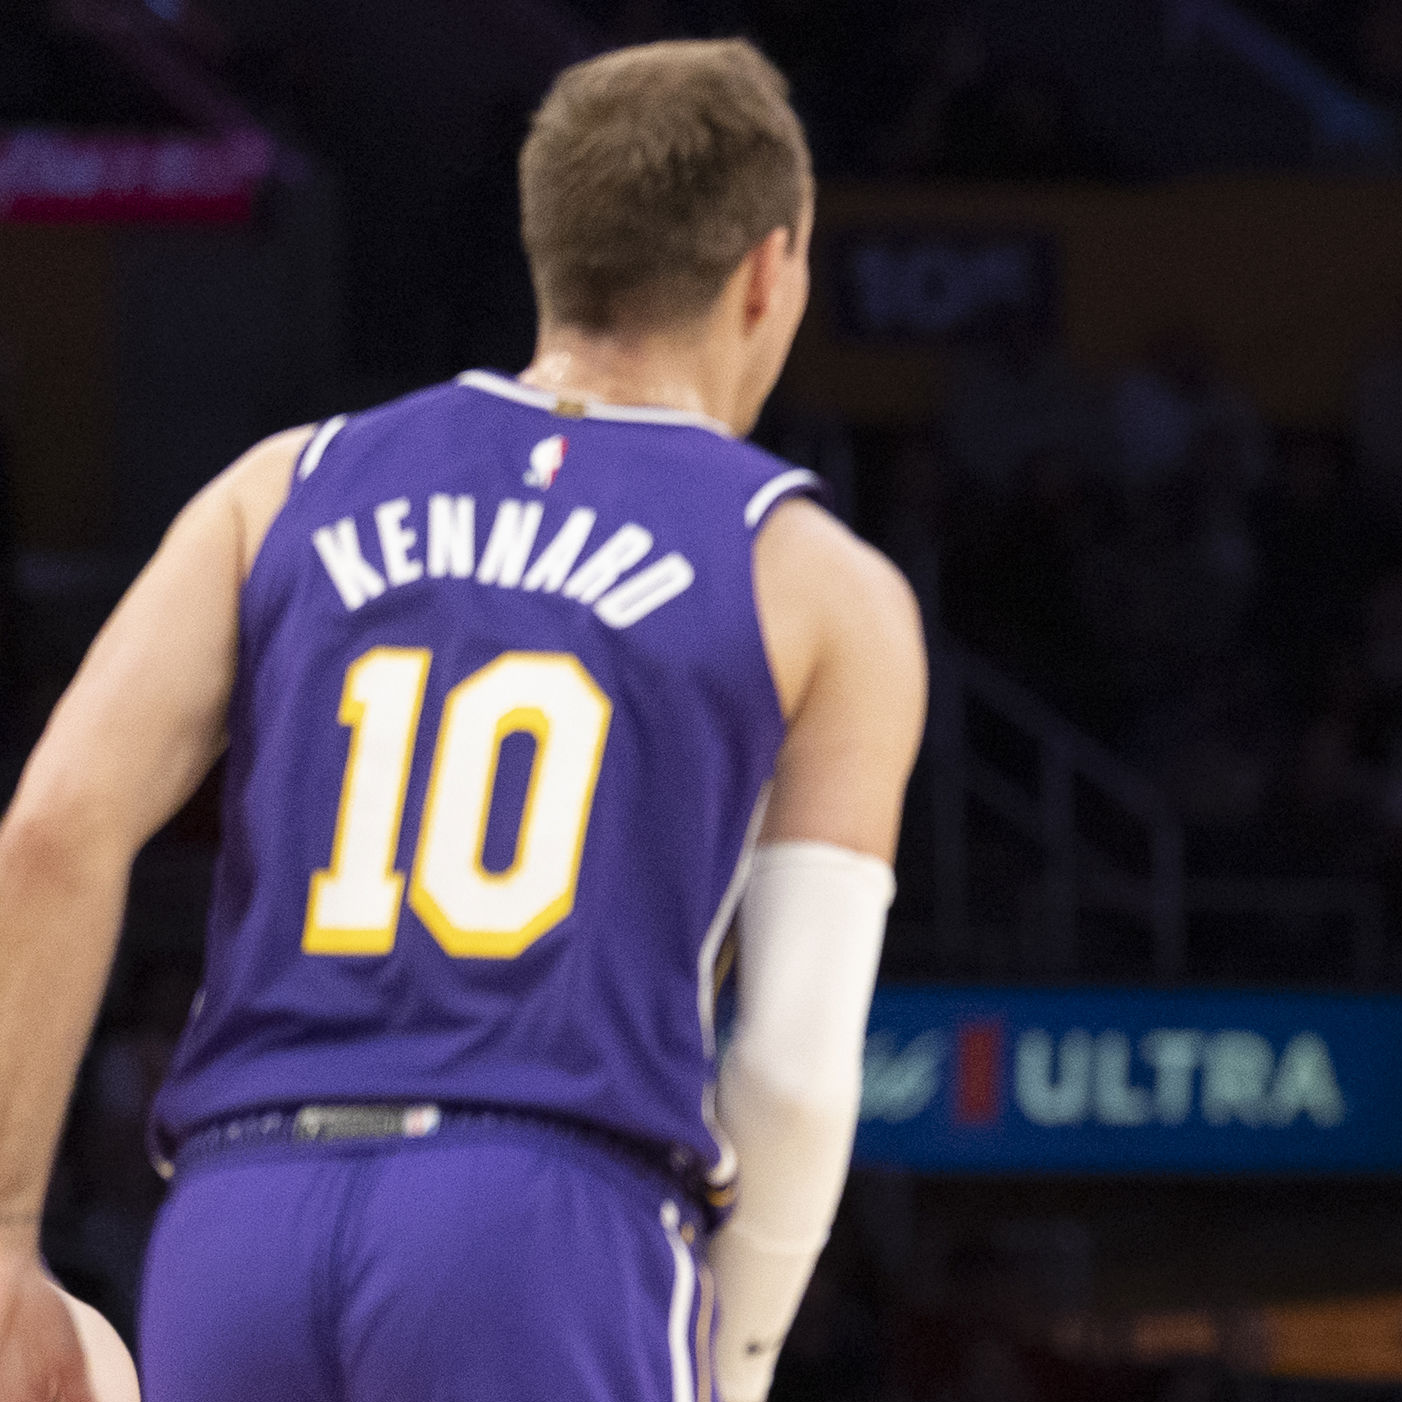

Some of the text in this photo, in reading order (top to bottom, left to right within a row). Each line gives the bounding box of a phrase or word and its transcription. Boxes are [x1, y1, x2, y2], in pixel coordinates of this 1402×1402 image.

[312, 492, 696, 630] KENNARD
[301, 644, 613, 960] 10
[1013, 1027, 1347, 1129] ULTRA
